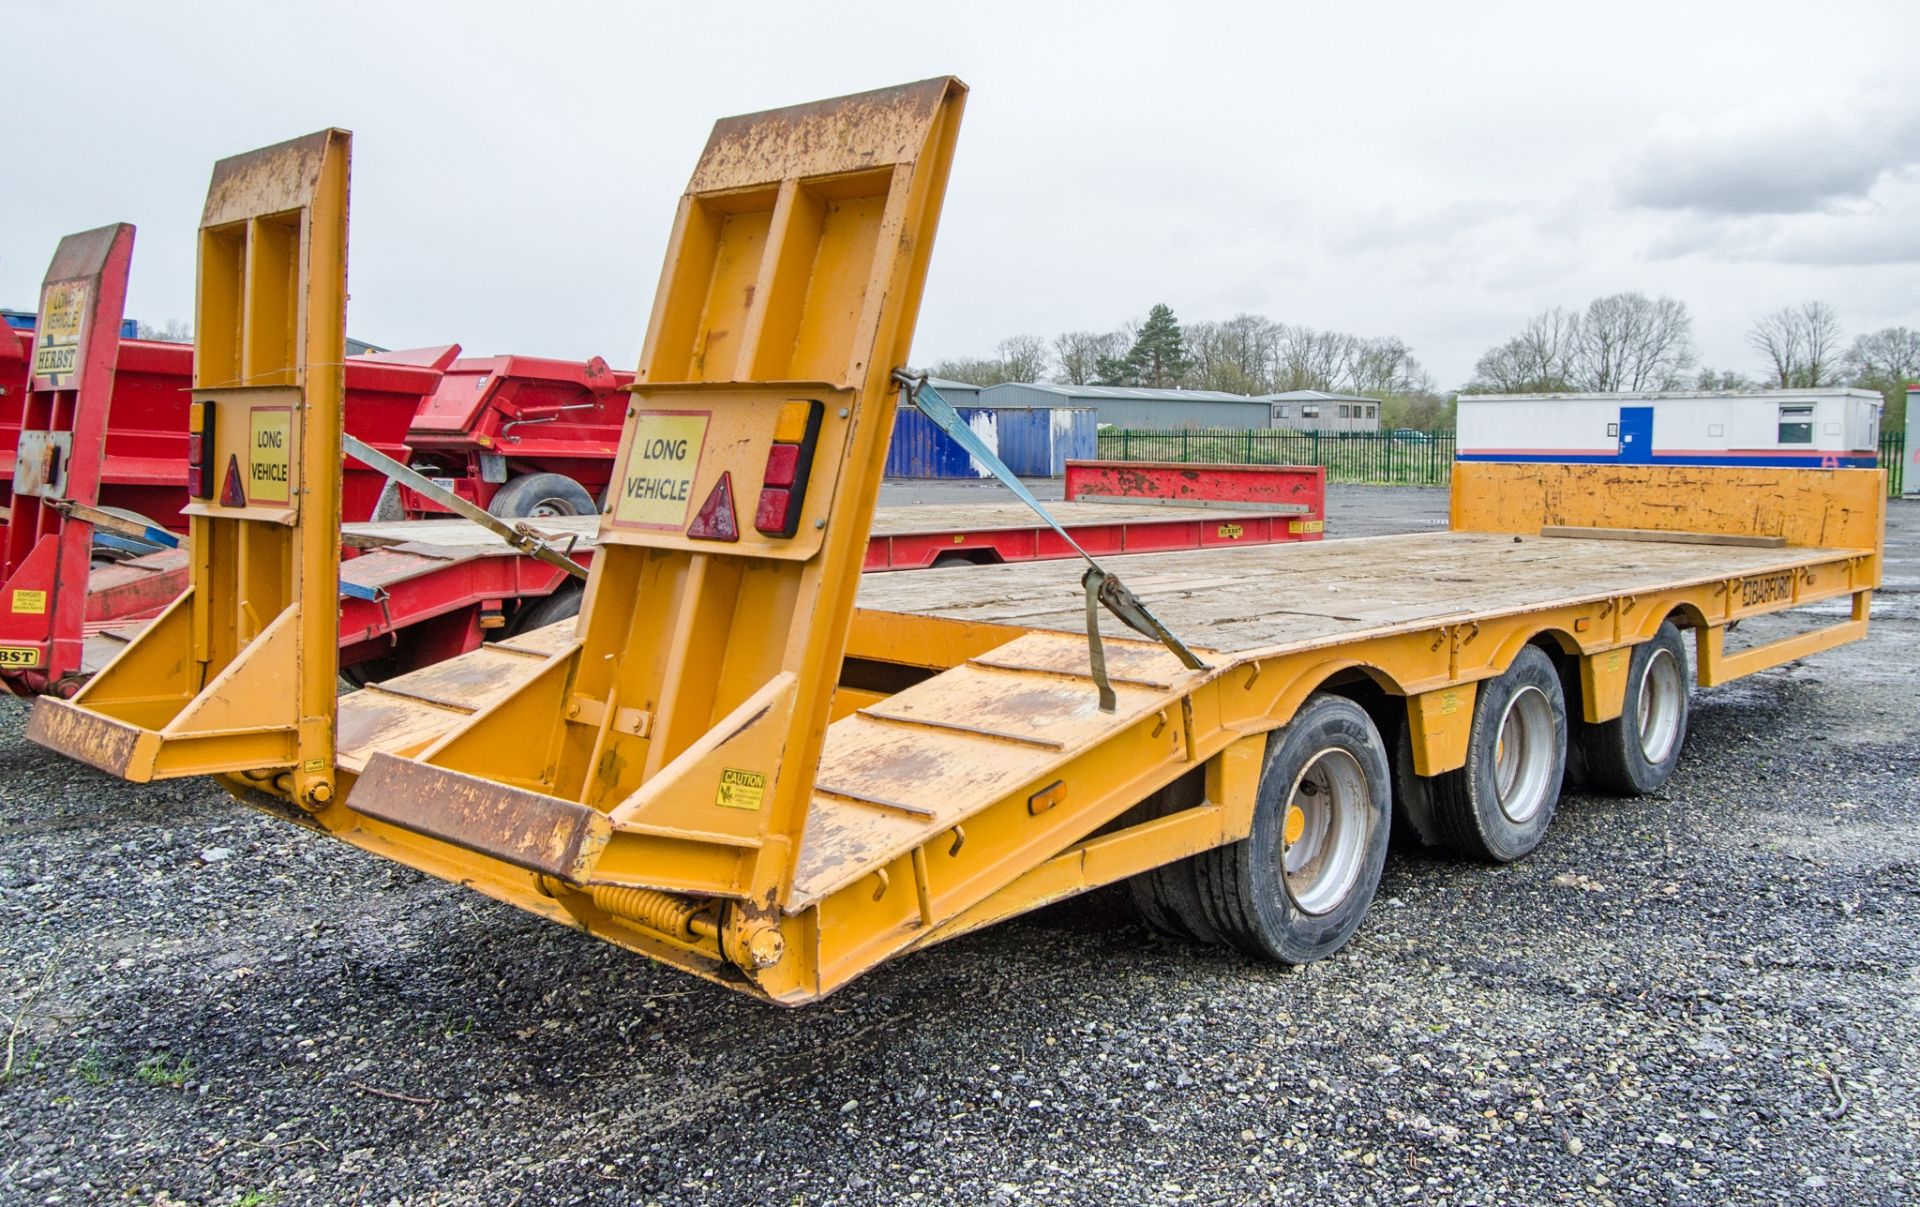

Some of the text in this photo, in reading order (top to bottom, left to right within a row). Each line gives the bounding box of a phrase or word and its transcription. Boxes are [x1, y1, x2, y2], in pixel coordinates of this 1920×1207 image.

[48, 311, 79, 330] VEHICLE
[38, 348, 76, 369] HERBST
[257, 431, 282, 449] LONG
[644, 439, 688, 461] LONG
[251, 462, 288, 482] VEHICLE
[627, 477, 689, 501] VEHICLE
[724, 771, 763, 788] CAUTION
